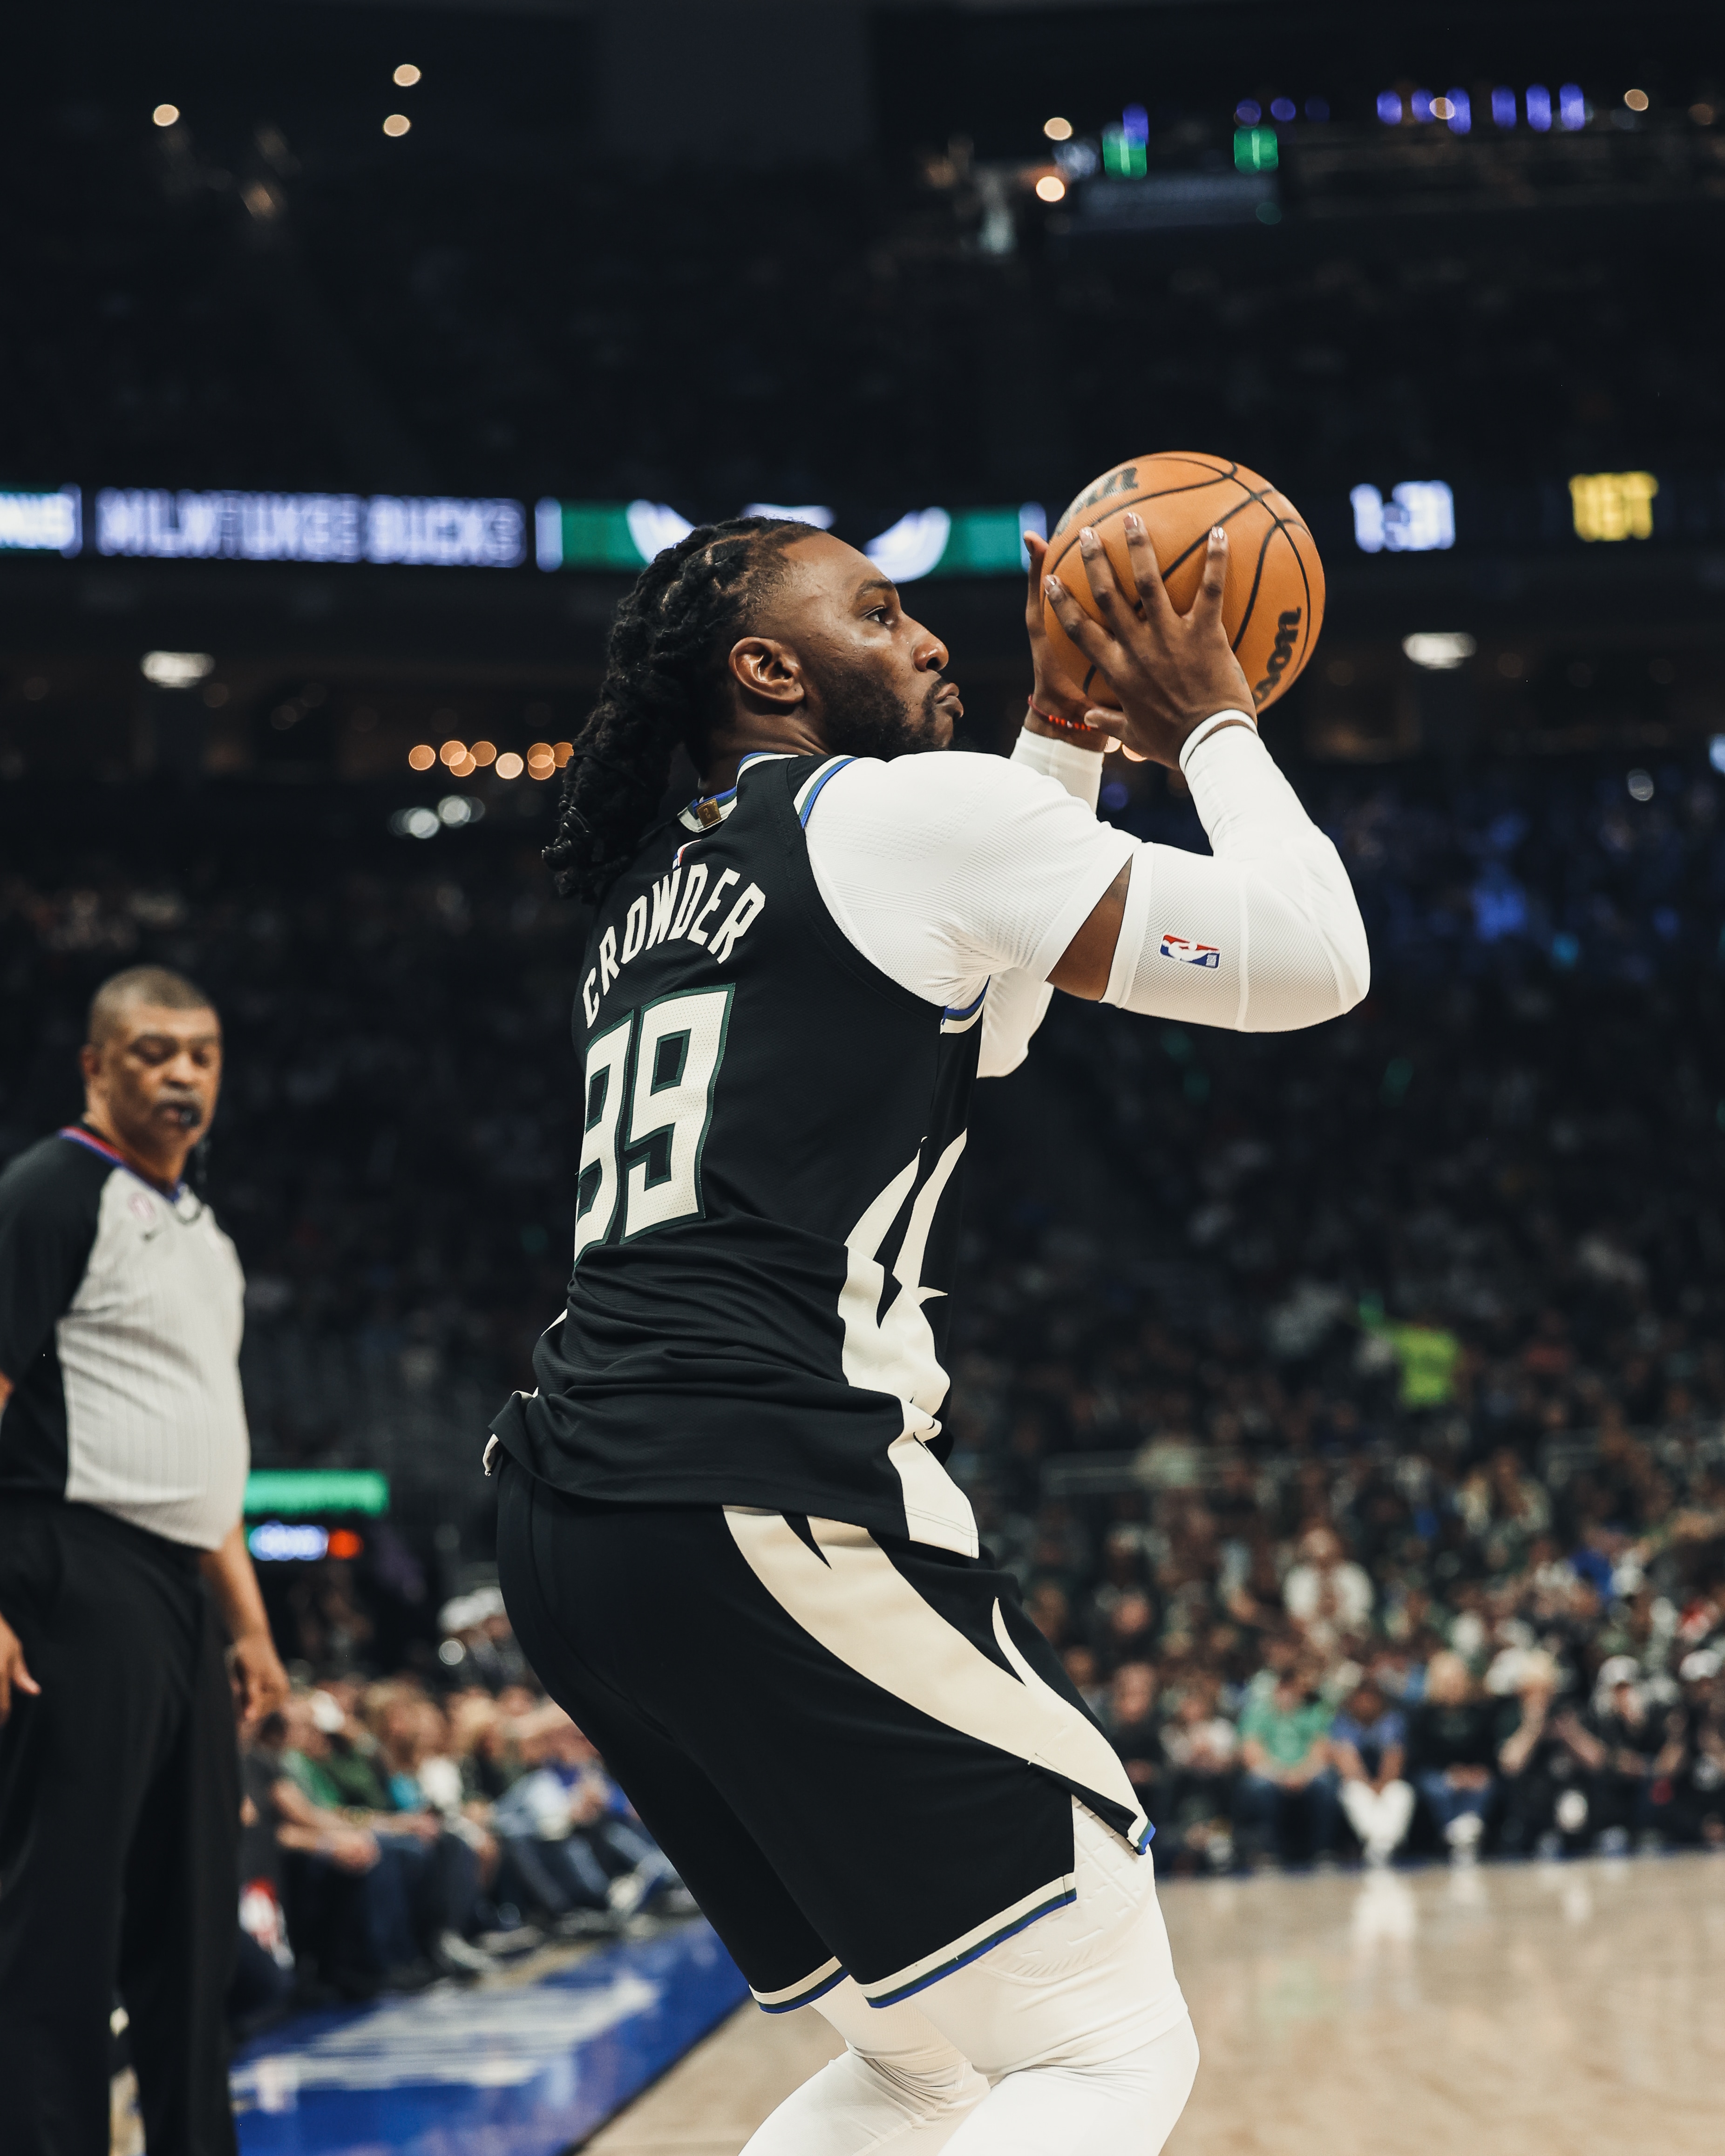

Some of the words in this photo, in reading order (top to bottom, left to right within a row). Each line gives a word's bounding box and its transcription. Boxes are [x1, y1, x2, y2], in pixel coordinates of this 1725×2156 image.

[365, 493, 527, 568] BUCKS
[583, 863, 766, 1029] CROWDER
[574, 983, 736, 1269] 99
